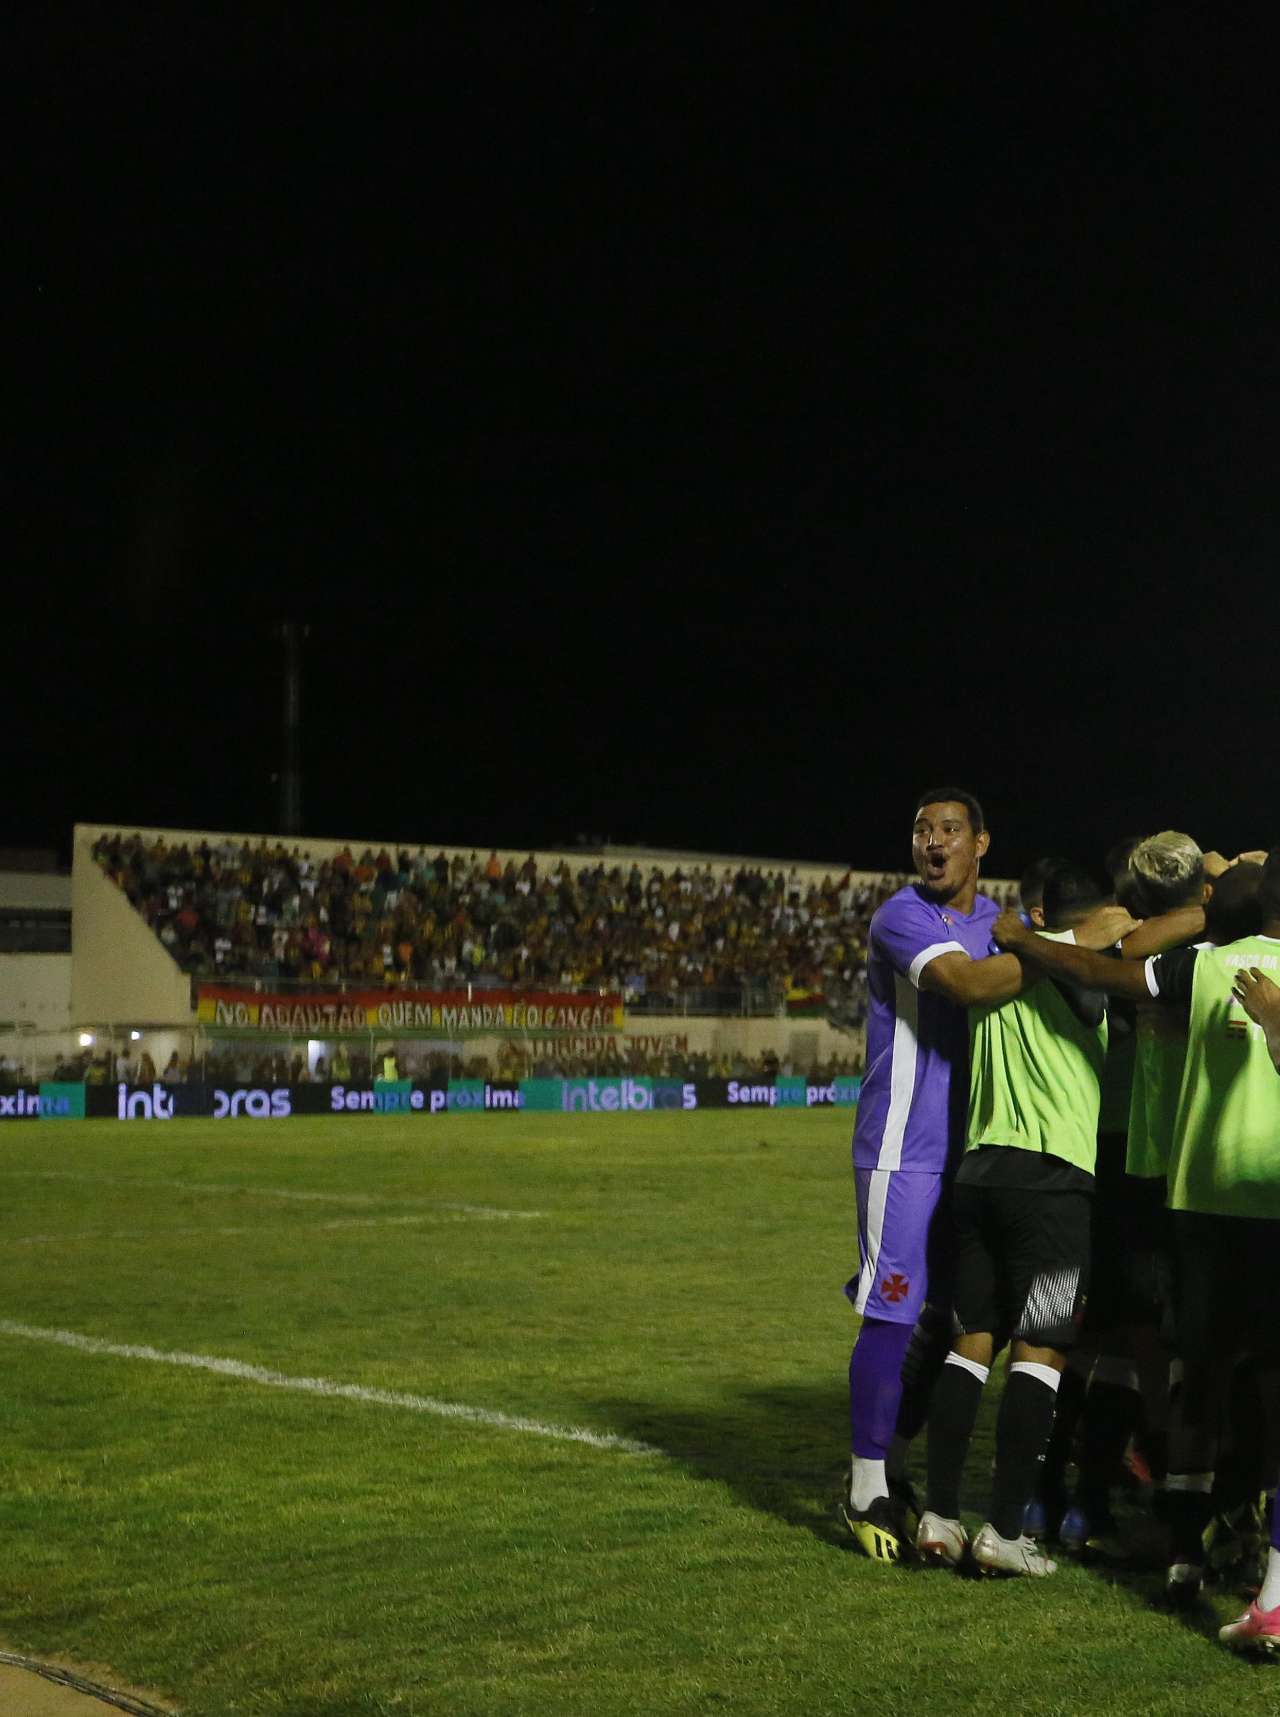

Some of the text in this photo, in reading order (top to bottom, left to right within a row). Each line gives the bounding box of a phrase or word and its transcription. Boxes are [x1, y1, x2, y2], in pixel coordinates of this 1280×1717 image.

[215, 1000, 249, 1027] NO
[378, 1001, 431, 1031] QUEM
[441, 1003, 504, 1030] MANDA
